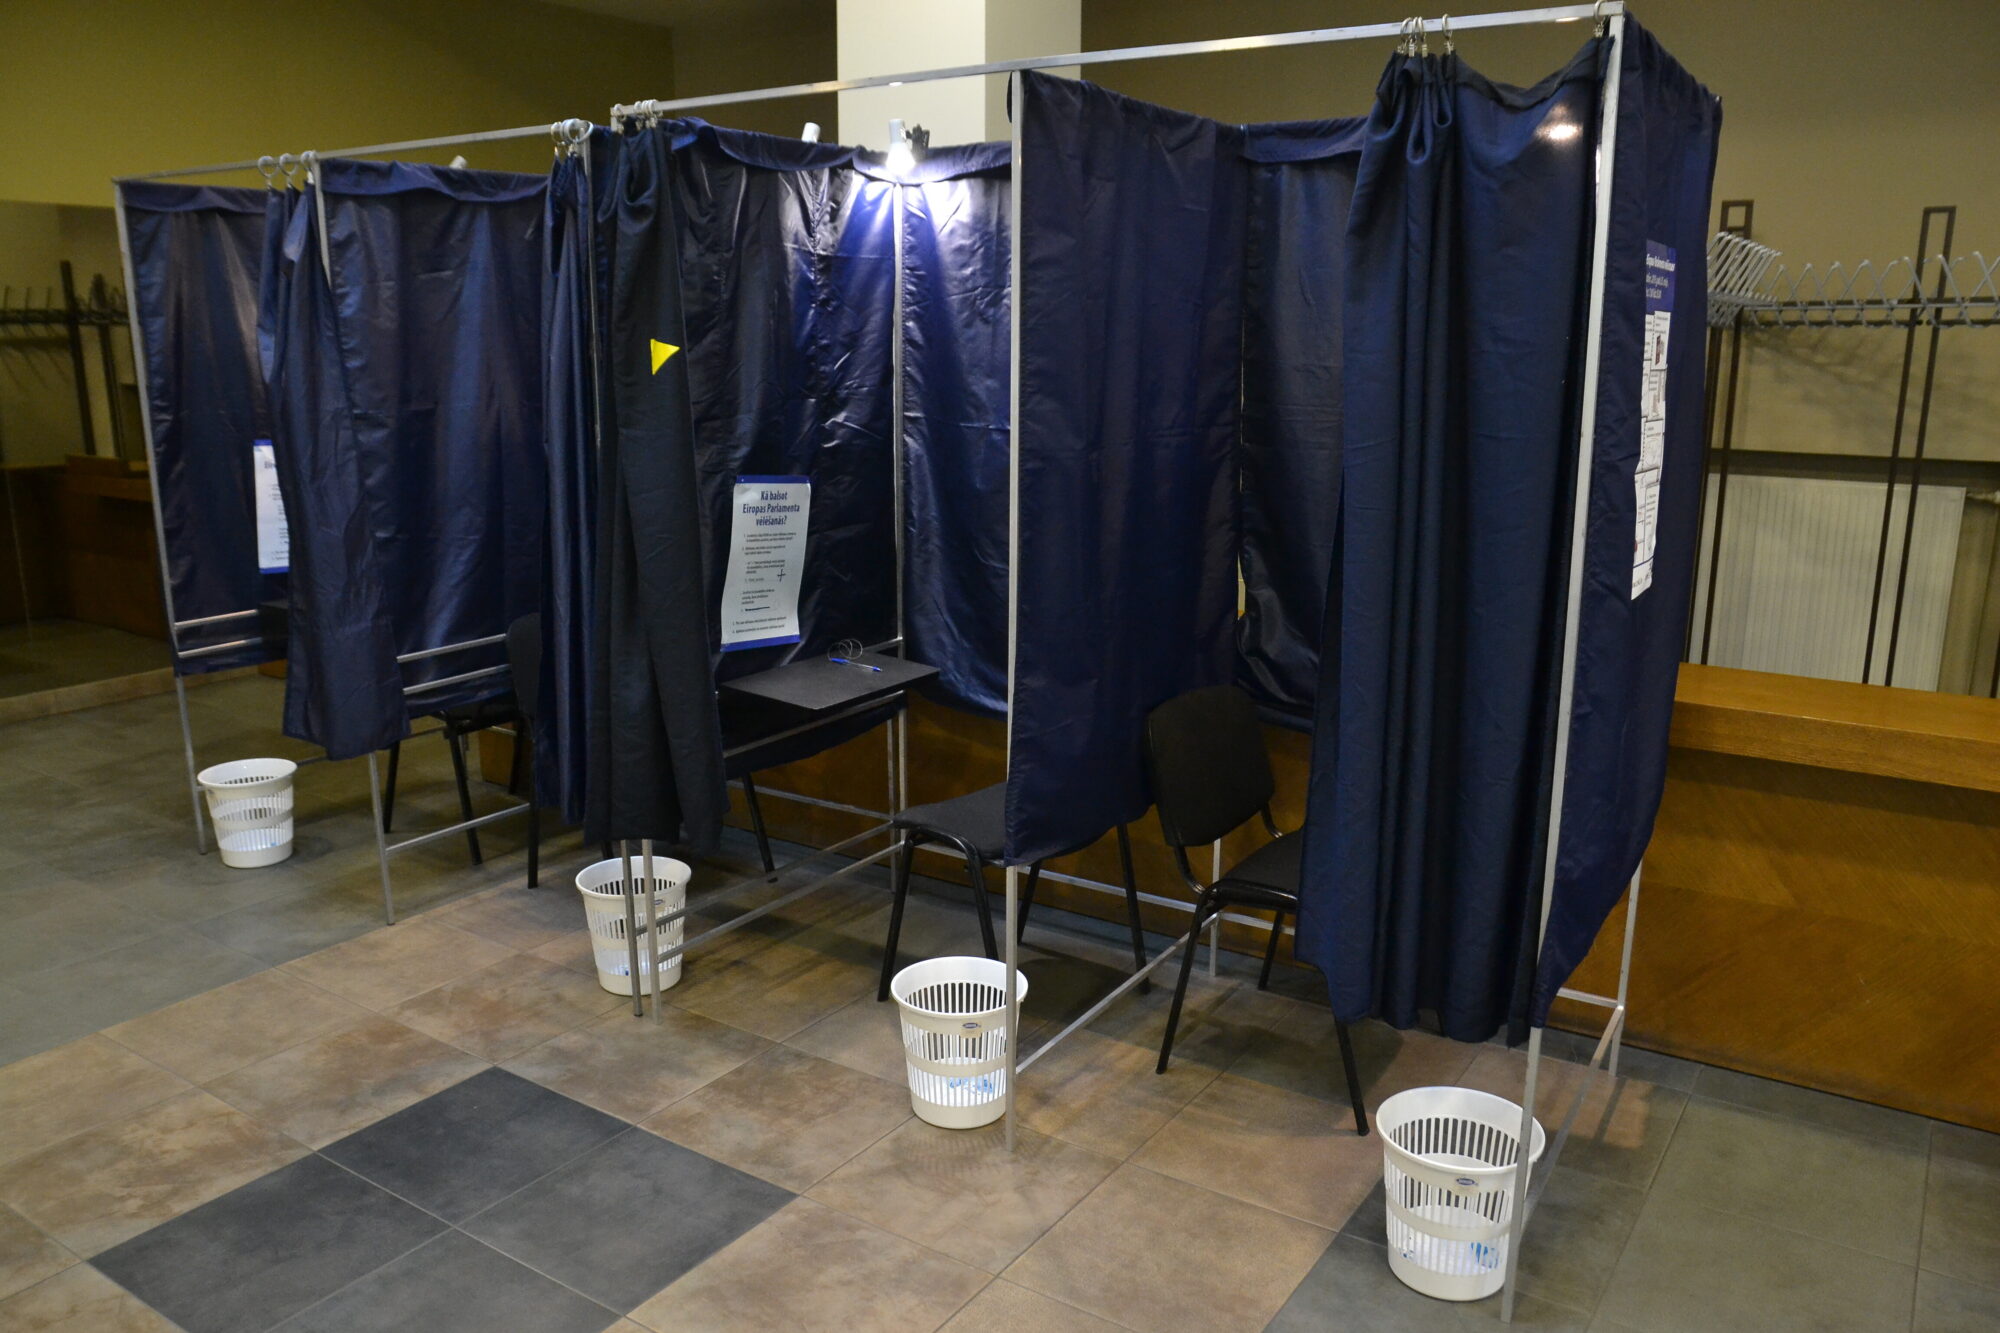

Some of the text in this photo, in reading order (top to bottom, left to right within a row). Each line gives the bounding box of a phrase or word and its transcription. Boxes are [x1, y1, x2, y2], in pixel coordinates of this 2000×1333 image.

[760, 490, 788, 500] Kā balsot
[742, 503, 800, 515] Eiropas Parlamenta
